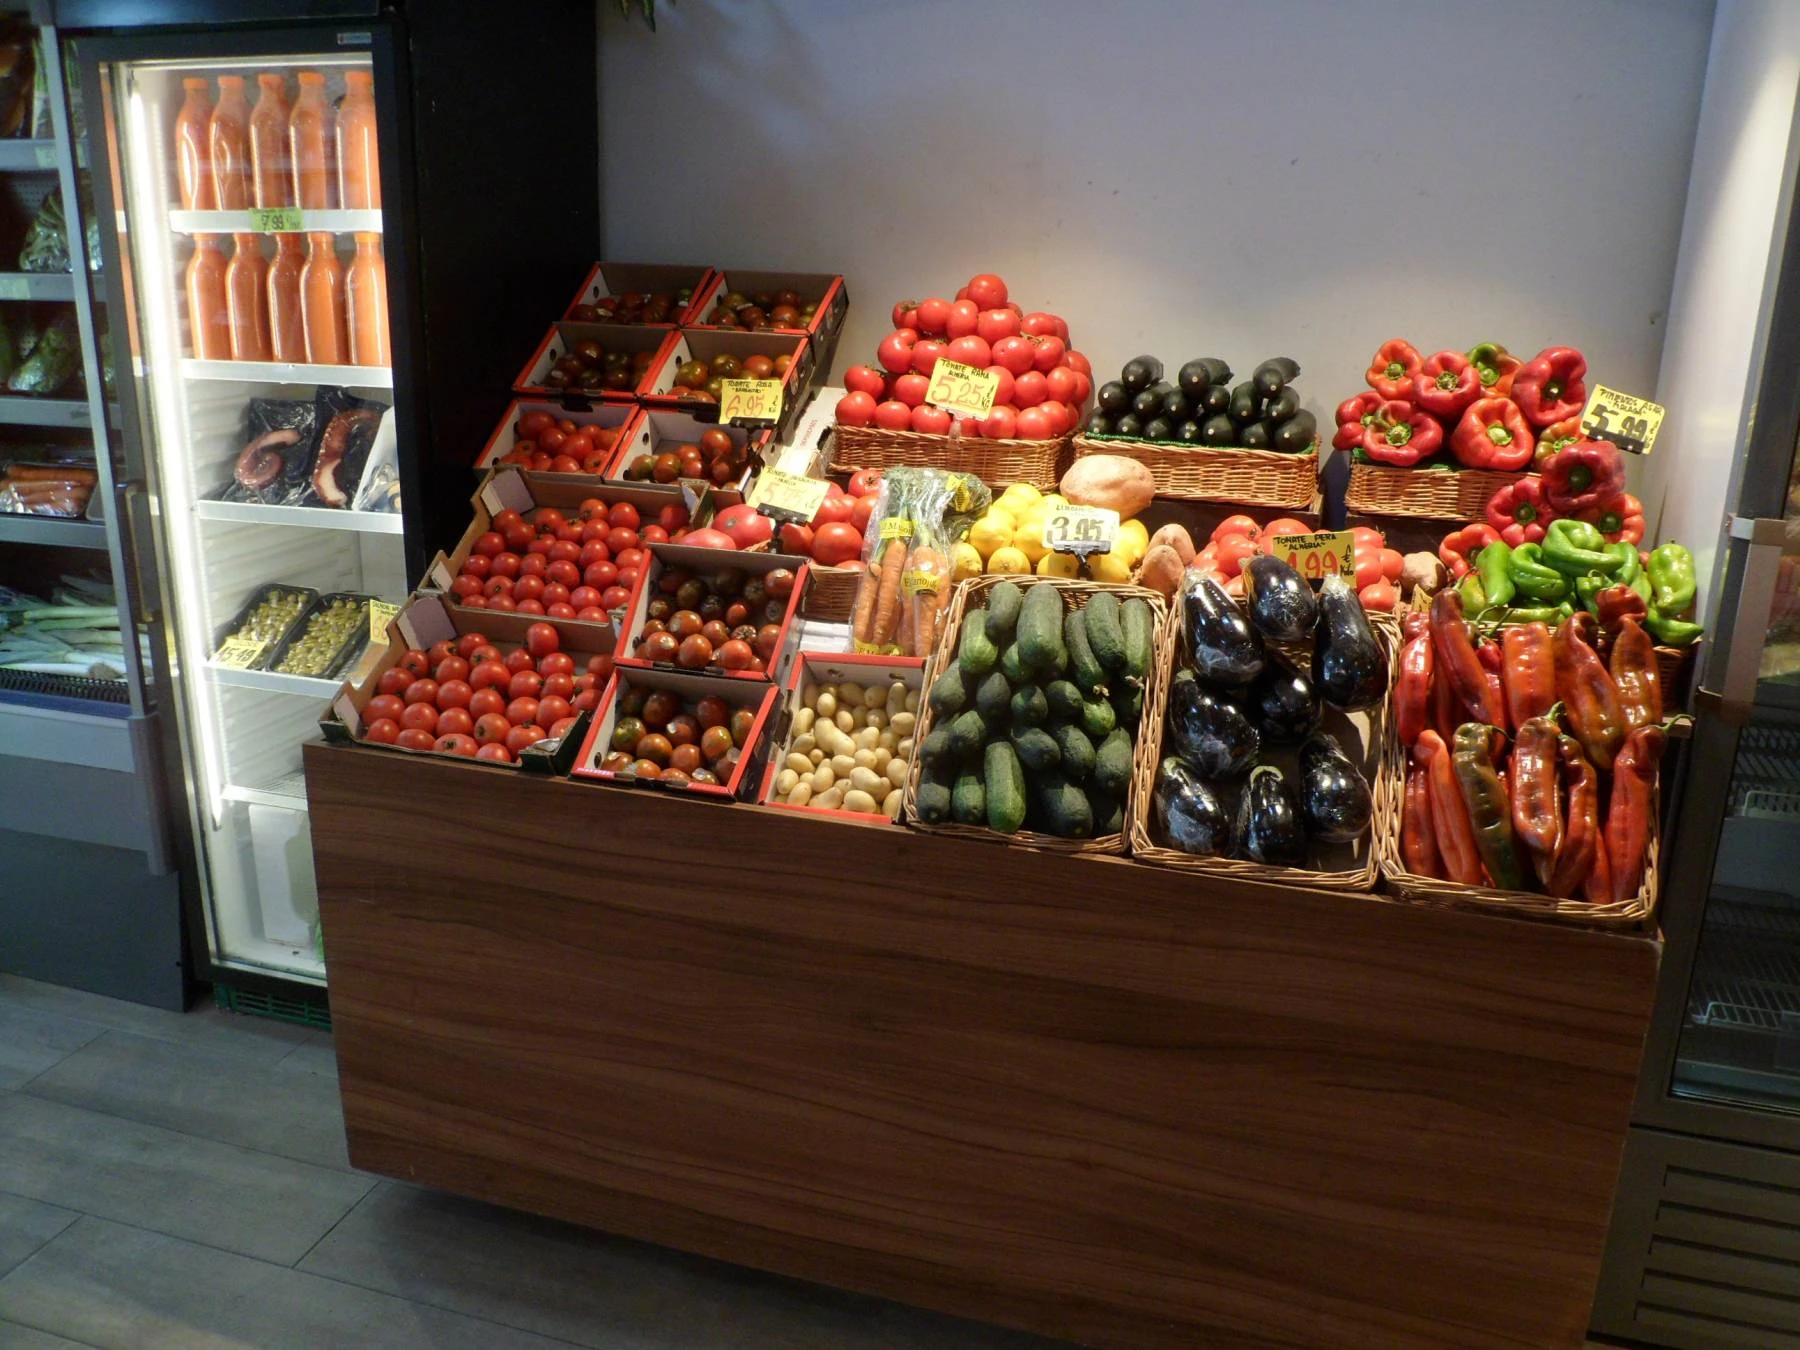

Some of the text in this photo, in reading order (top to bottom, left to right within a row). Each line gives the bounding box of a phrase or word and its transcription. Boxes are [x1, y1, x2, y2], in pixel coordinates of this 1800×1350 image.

[941, 359, 990, 379] TOMATE RAMA
[1274, 533, 1337, 545] TOMATE PERA
